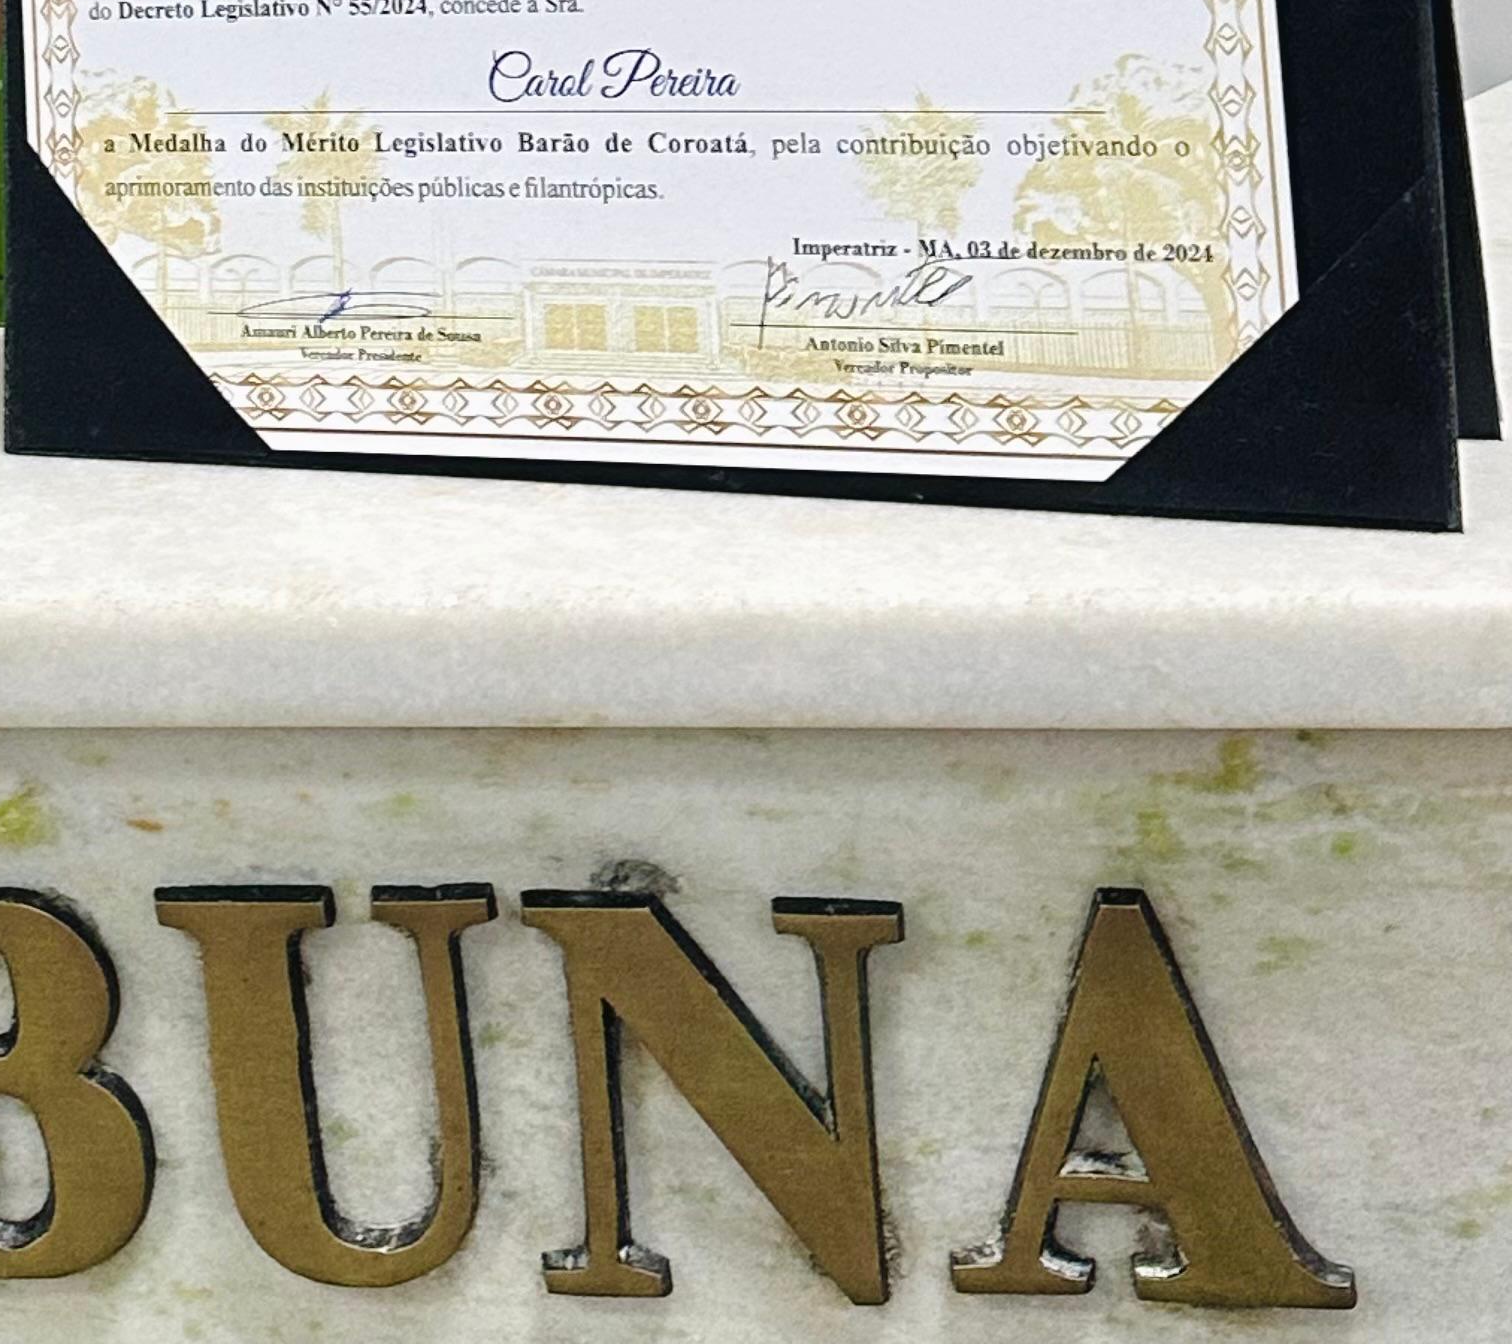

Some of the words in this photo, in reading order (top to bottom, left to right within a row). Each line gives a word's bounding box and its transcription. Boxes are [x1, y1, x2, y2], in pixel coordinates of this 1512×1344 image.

[88, 1, 112, 20] do
[118, 0, 193, 19] Decreto
[489, 50, 595, 102] Carol
[601, 47, 741, 98] Pereira
[104, 138, 115, 153] a
[129, 133, 225, 153] Medalha
[241, 133, 267, 153] do
[282, 131, 360, 152] Mérito
[374, 132, 503, 158] Legislativo
[518, 132, 589, 153] Barão
[605, 133, 632, 153] de
[648, 132, 757, 158] Coroatá,
[772, 134, 821, 161] pela
[837, 134, 990, 161] contribuição
[1007, 135, 1157, 162] objetivando
[1174, 142, 1190, 158] o
[105, 176, 255, 201] aprimoramento
[259, 176, 292, 197] das
[297, 176, 413, 202] instituições
[419, 176, 504, 202] públicas
[509, 182, 520, 198] e
[525, 176, 665, 203] filantrópicas.
[793, 237, 897, 261] Imperatriz
[967, 241, 991, 257] 03
[998, 241, 1020, 259] de
[1026, 242, 1126, 262] dezembro
[1133, 244, 1157, 262] de
[1163, 244, 1214, 262] 2024
[302, 325, 356, 340] Alberto
[360, 327, 412, 341] Pereira
[418, 328, 433, 341] de
[806, 338, 874, 352] Antonio
[878, 338, 922, 353] Silva
[926, 338, 1004, 355] Pimentel
